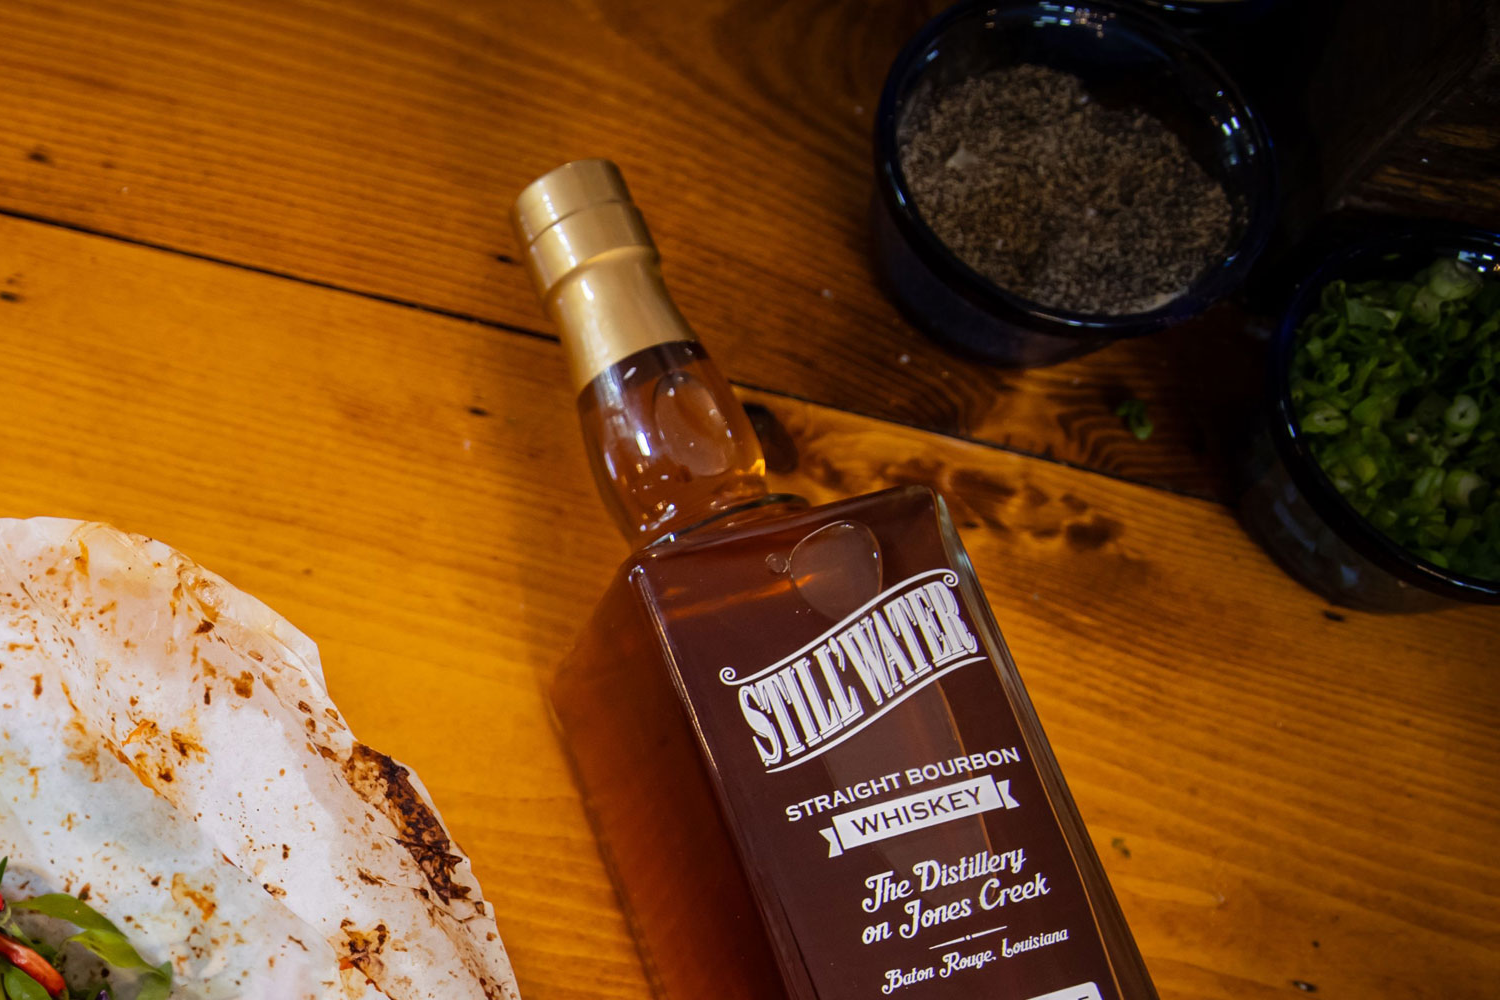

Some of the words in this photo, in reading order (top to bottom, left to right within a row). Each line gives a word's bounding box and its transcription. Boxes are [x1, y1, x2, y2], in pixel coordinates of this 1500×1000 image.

[785, 772, 900, 822] STRAIGHT
[905, 746, 1021, 787] BOURBON
[850, 786, 982, 837] WHISKEY
[861, 871, 912, 913] The
[913, 847, 1027, 893] Distillery
[861, 921, 892, 945] on
[899, 900, 972, 939] Jones
[979, 873, 1051, 910] Creek
[881, 967, 935, 995] Baton
[1001, 929, 1069, 958] Louisiana
